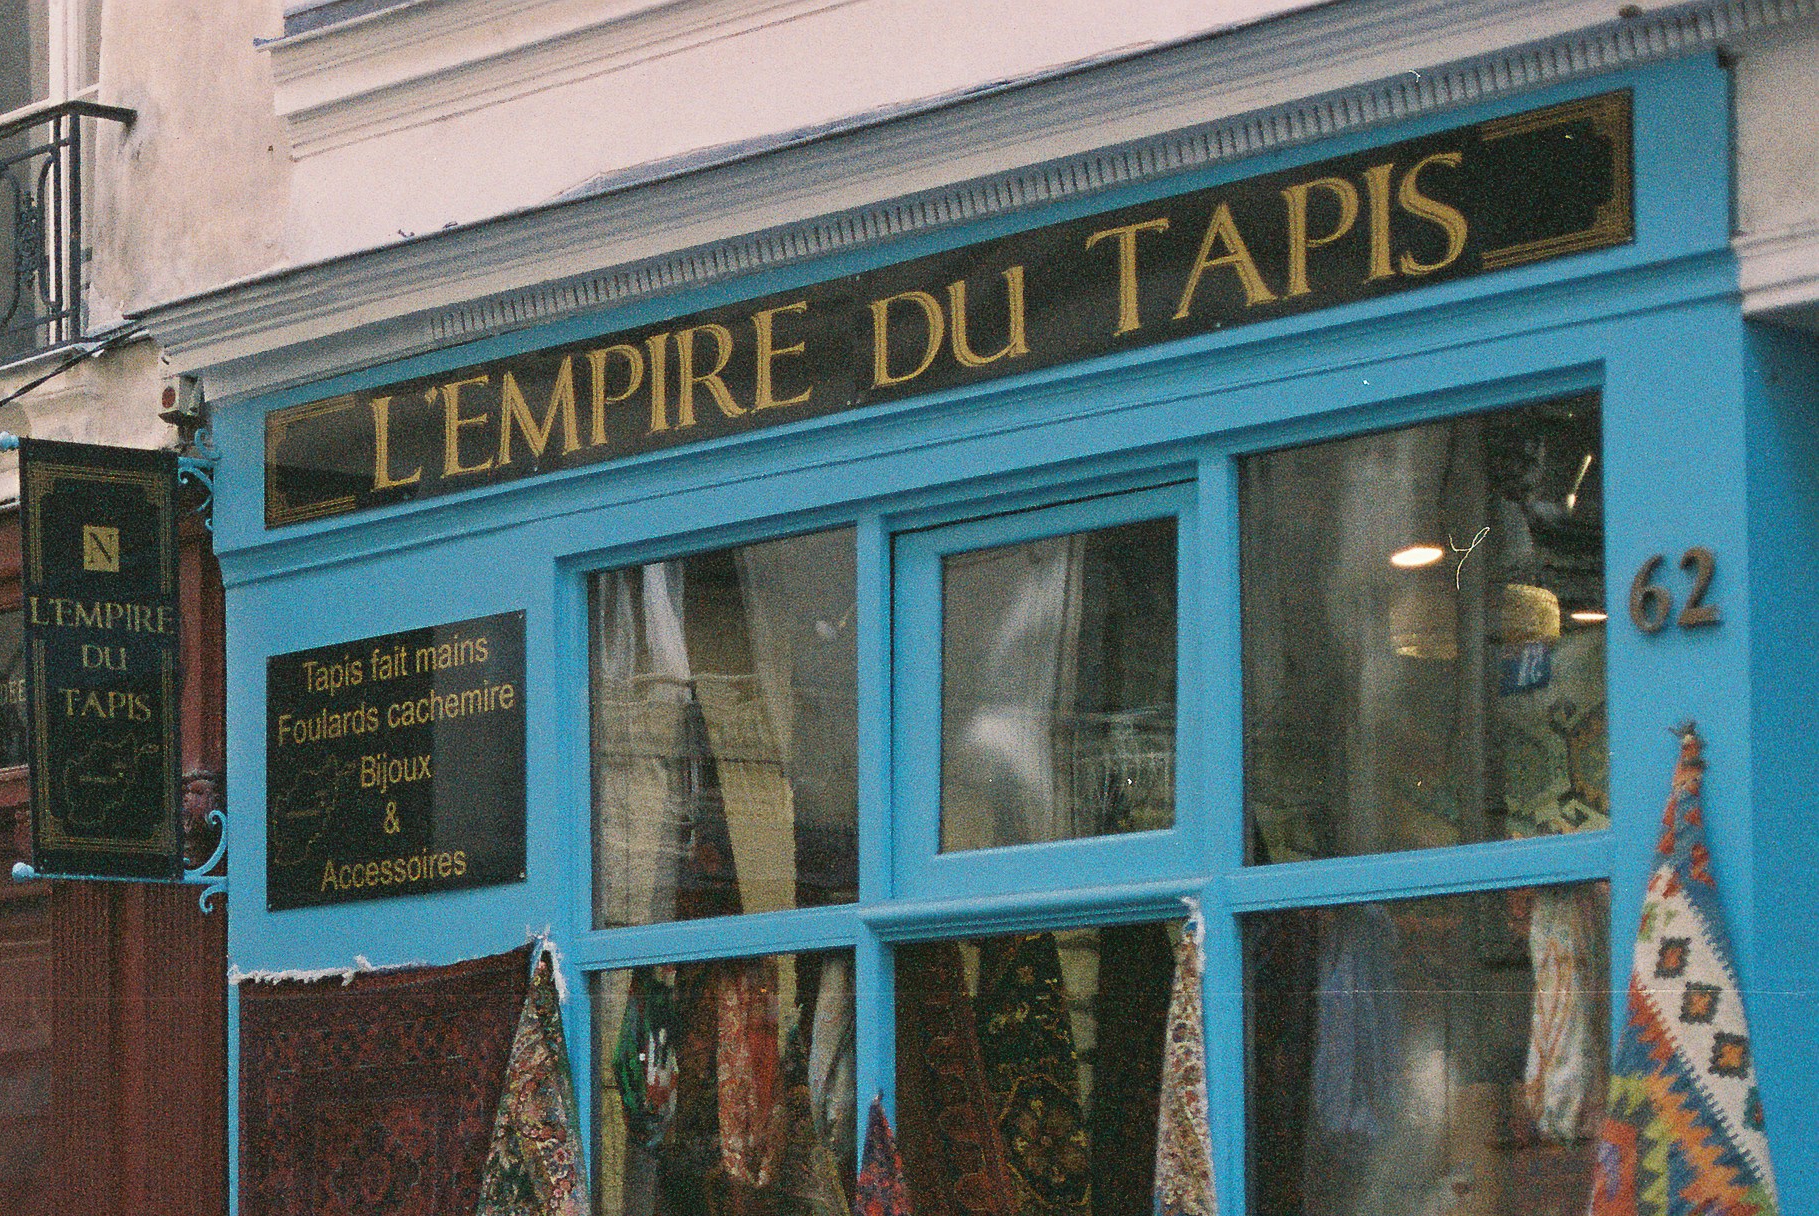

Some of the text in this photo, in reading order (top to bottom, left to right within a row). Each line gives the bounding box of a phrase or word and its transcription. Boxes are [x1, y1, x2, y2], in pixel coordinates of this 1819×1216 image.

[368, 151, 1470, 493] L'EMPIRE DU TAPIS
[1628, 547, 1723, 635] 62
[29, 596, 173, 635] L'EMPIRE
[81, 643, 127, 672] DU
[302, 634, 490, 697] Tapis fait mains
[59, 687, 152, 722] TAPIS
[277, 678, 515, 748] Foulards cachemire
[360, 752, 433, 794] Bijoux
[383, 801, 400, 834] &
[320, 847, 468, 892] Accessoires
